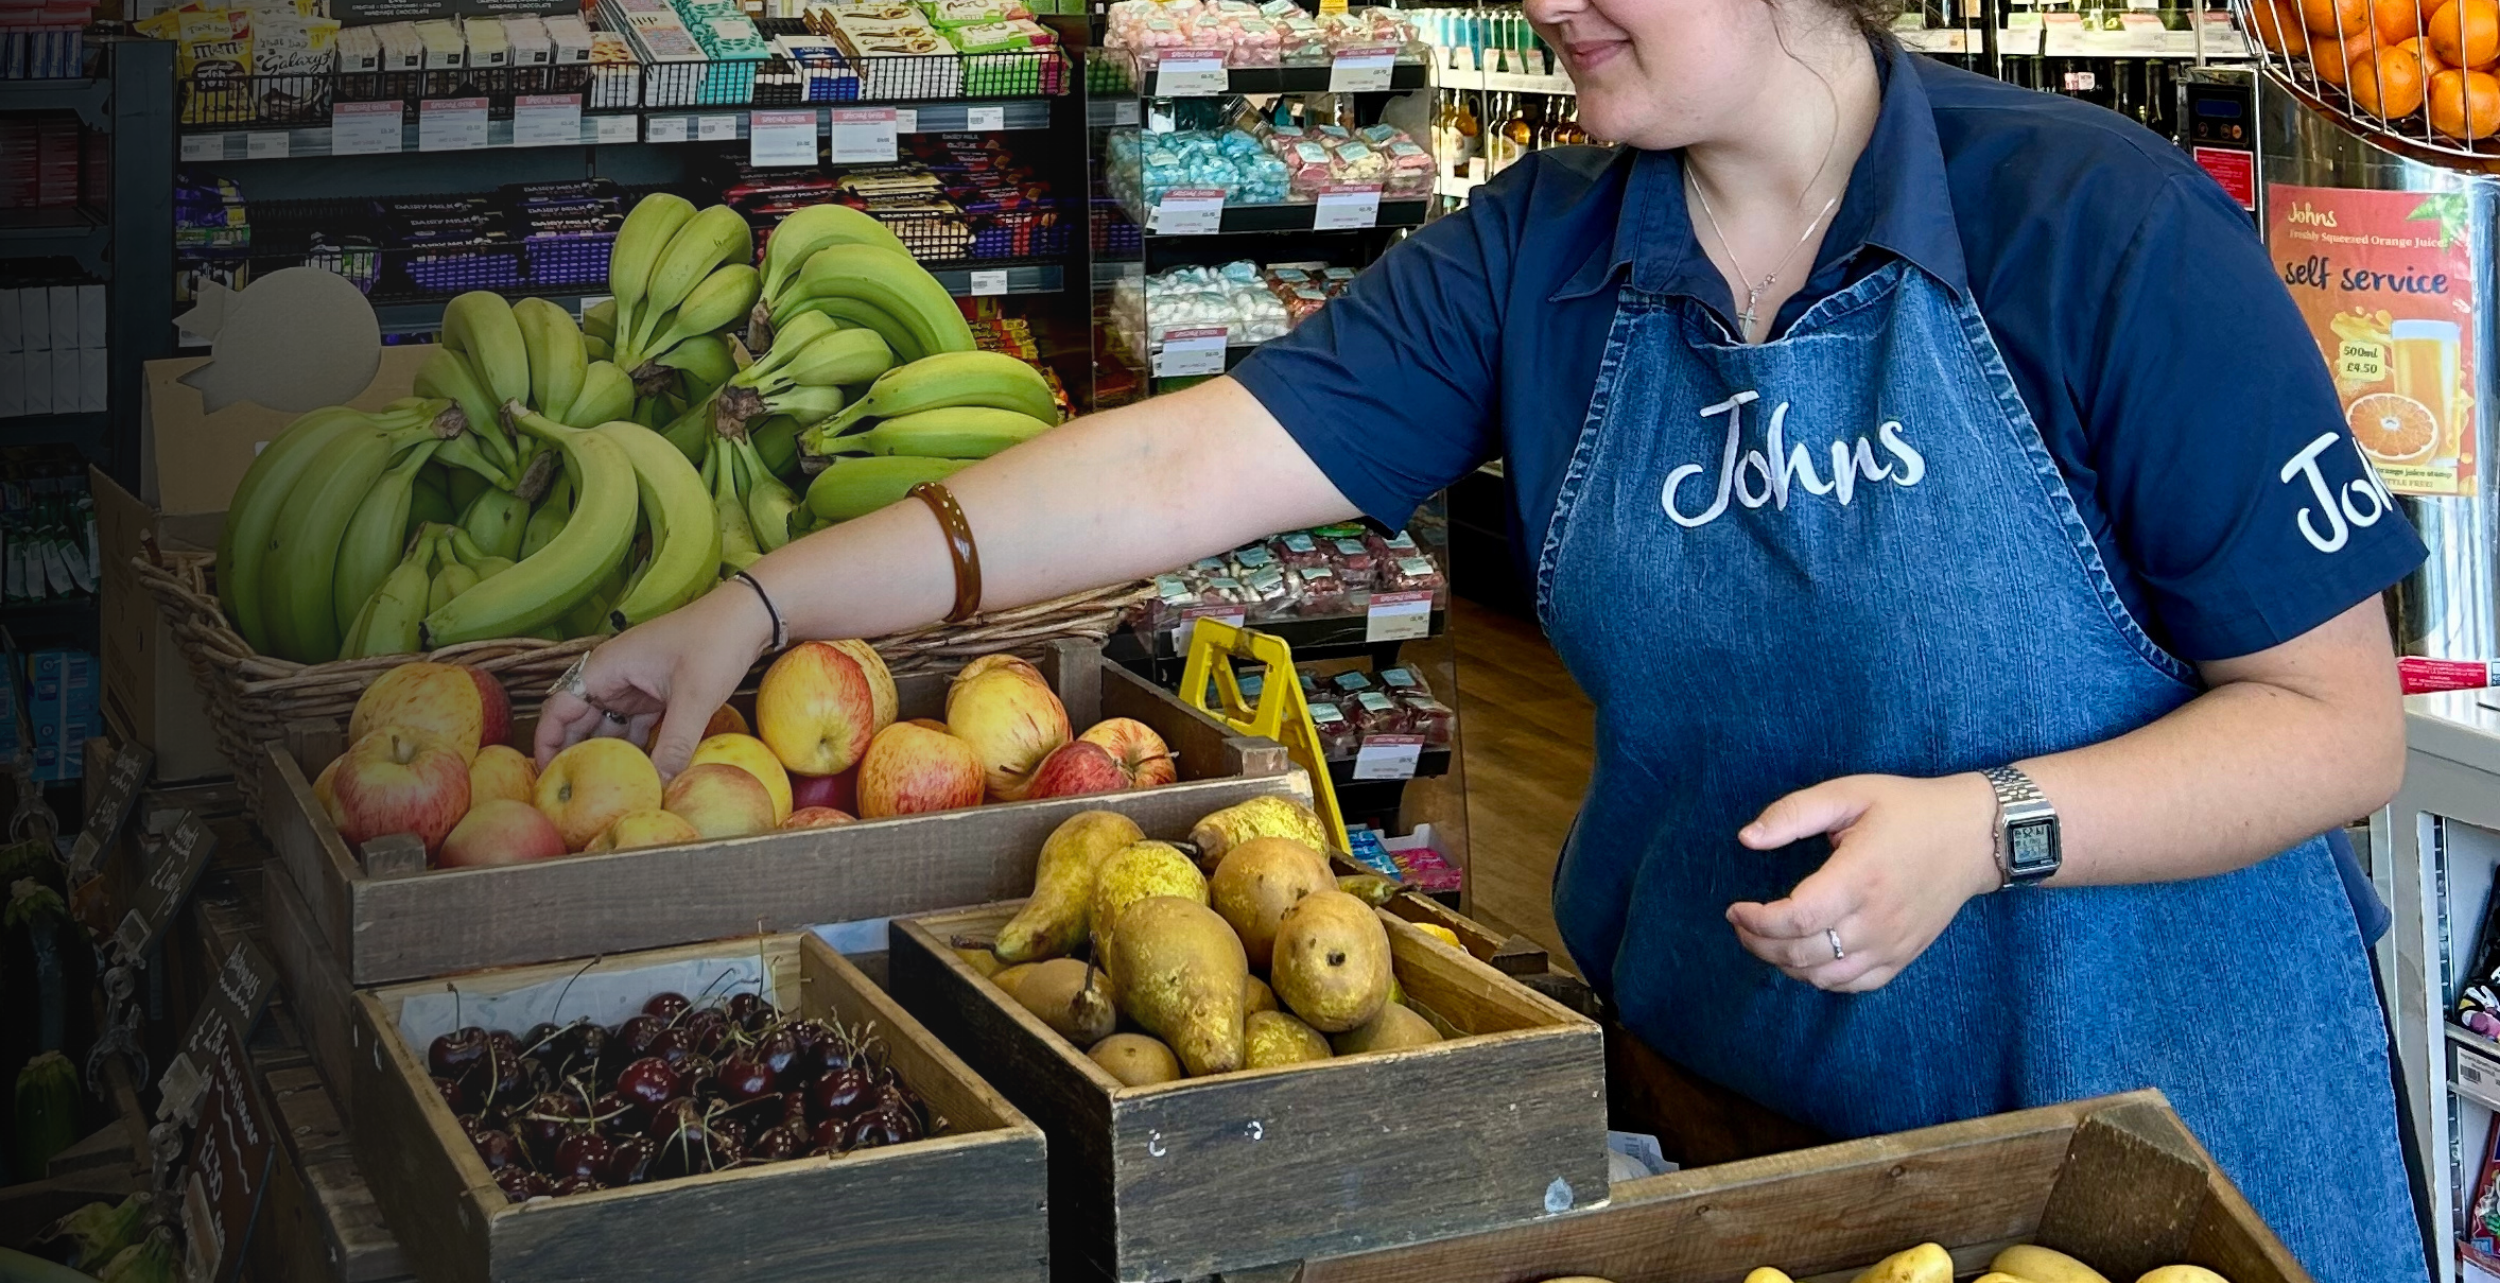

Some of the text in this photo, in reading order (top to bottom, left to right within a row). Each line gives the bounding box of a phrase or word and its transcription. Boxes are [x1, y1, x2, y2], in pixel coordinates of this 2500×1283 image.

[261, 48, 332, 74] Galaxy
[2288, 201, 2338, 228] Johns
[2289, 229, 2320, 243] Freshly
[2321, 231, 2369, 247] Squeezed
[2370, 235, 2412, 248] Orange
[2285, 254, 2449, 295] self service
[2343, 345, 2379, 358] 500ml
[2346, 362, 2378, 374] £4.50
[1661, 389, 1926, 528] Johns
